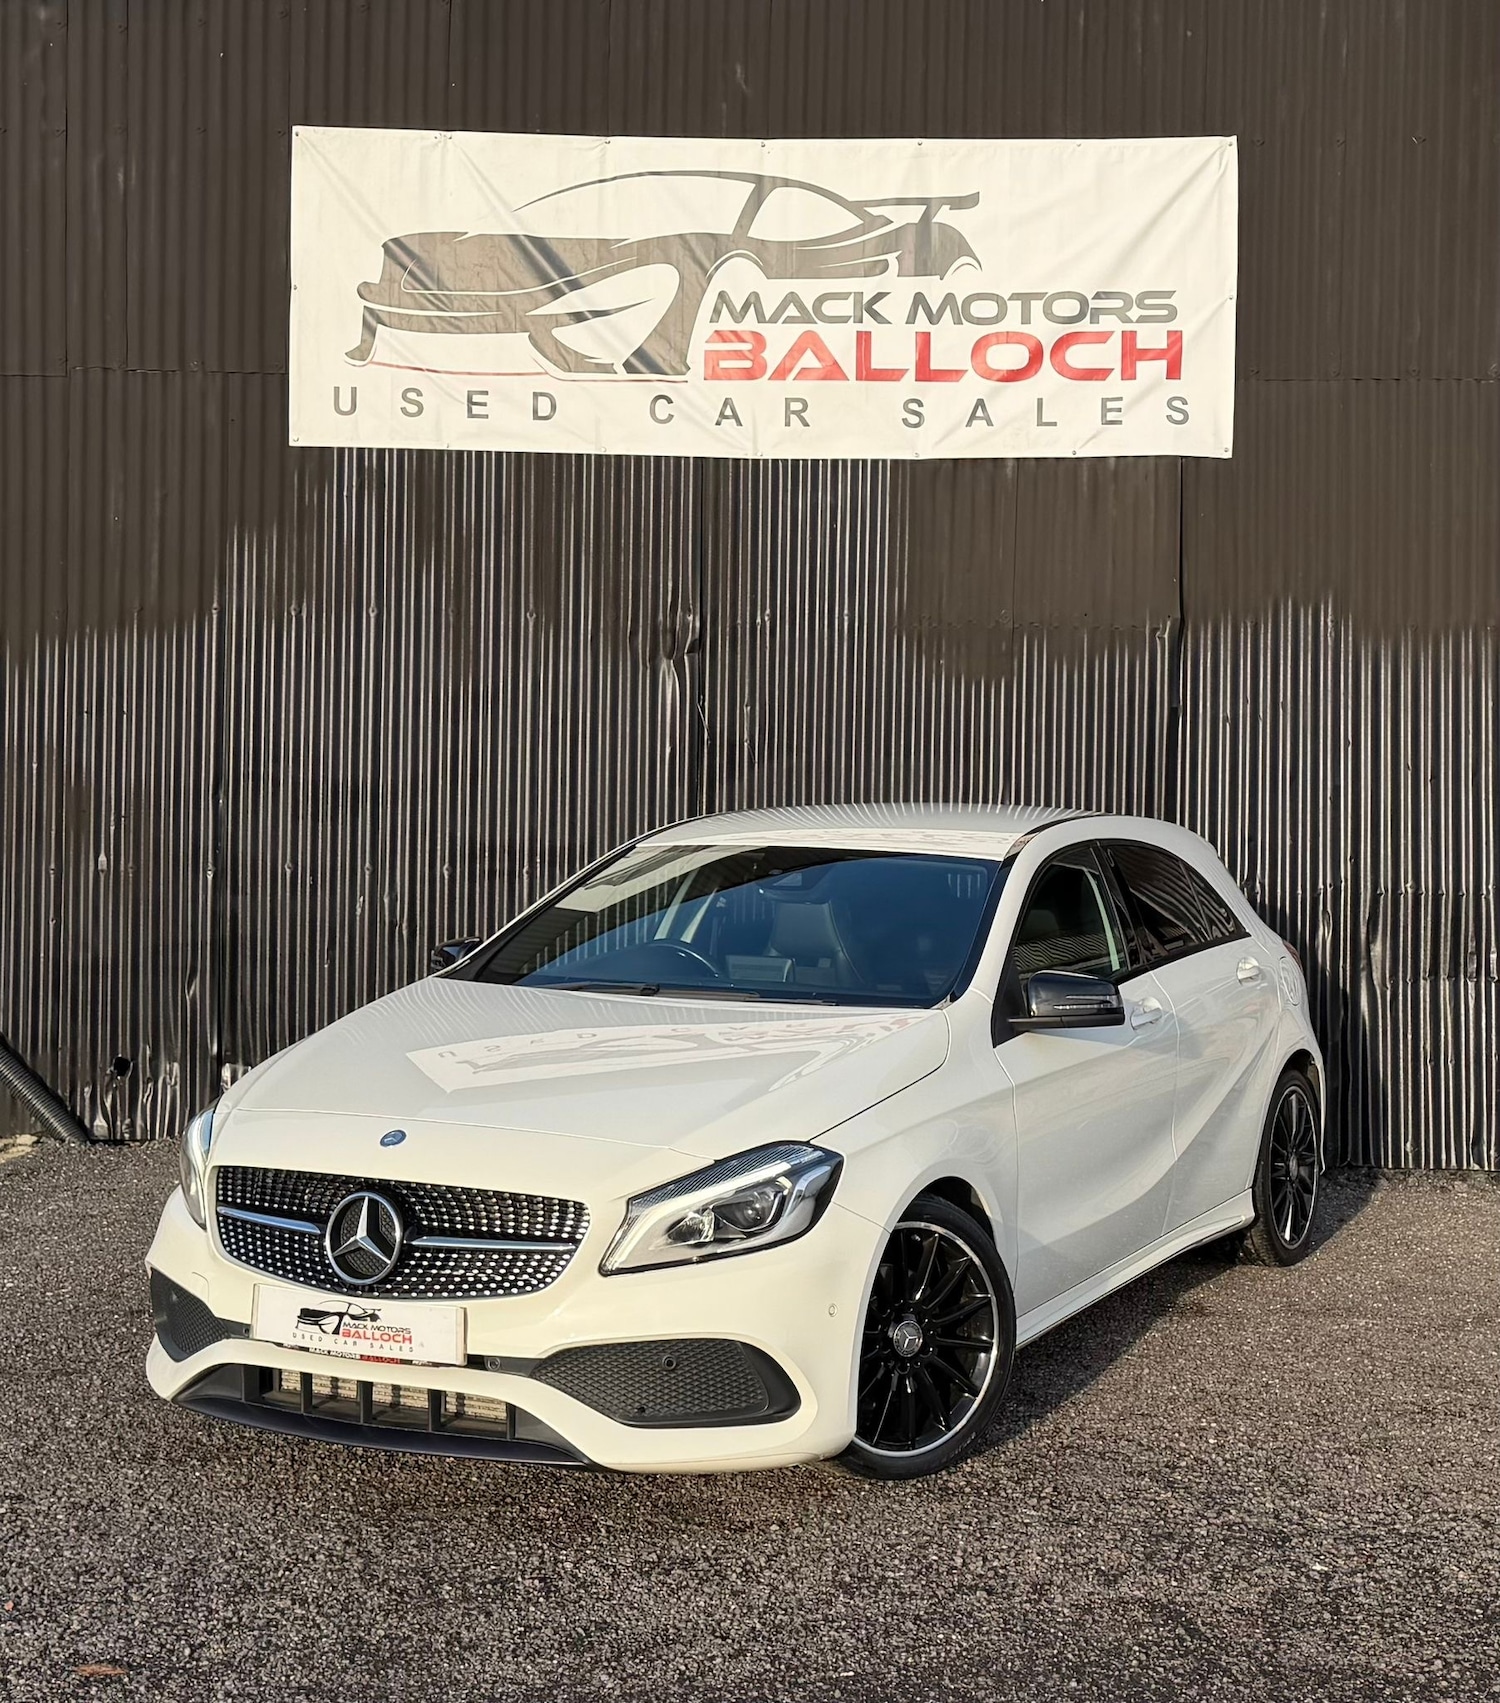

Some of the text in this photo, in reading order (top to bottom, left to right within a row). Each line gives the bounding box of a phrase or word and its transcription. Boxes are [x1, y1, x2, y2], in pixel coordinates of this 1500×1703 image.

[709, 290, 1177, 325] MACK MOTORS
[703, 329, 1183, 383] BALLOCH
[333, 386, 1190, 429] USED CAR SALES
[292, 1332, 323, 1342] USED
[333, 1338, 358, 1347] CAR
[341, 1328, 413, 1345] BALLOCH
[342, 1321, 412, 1335] MACK MOTORS
